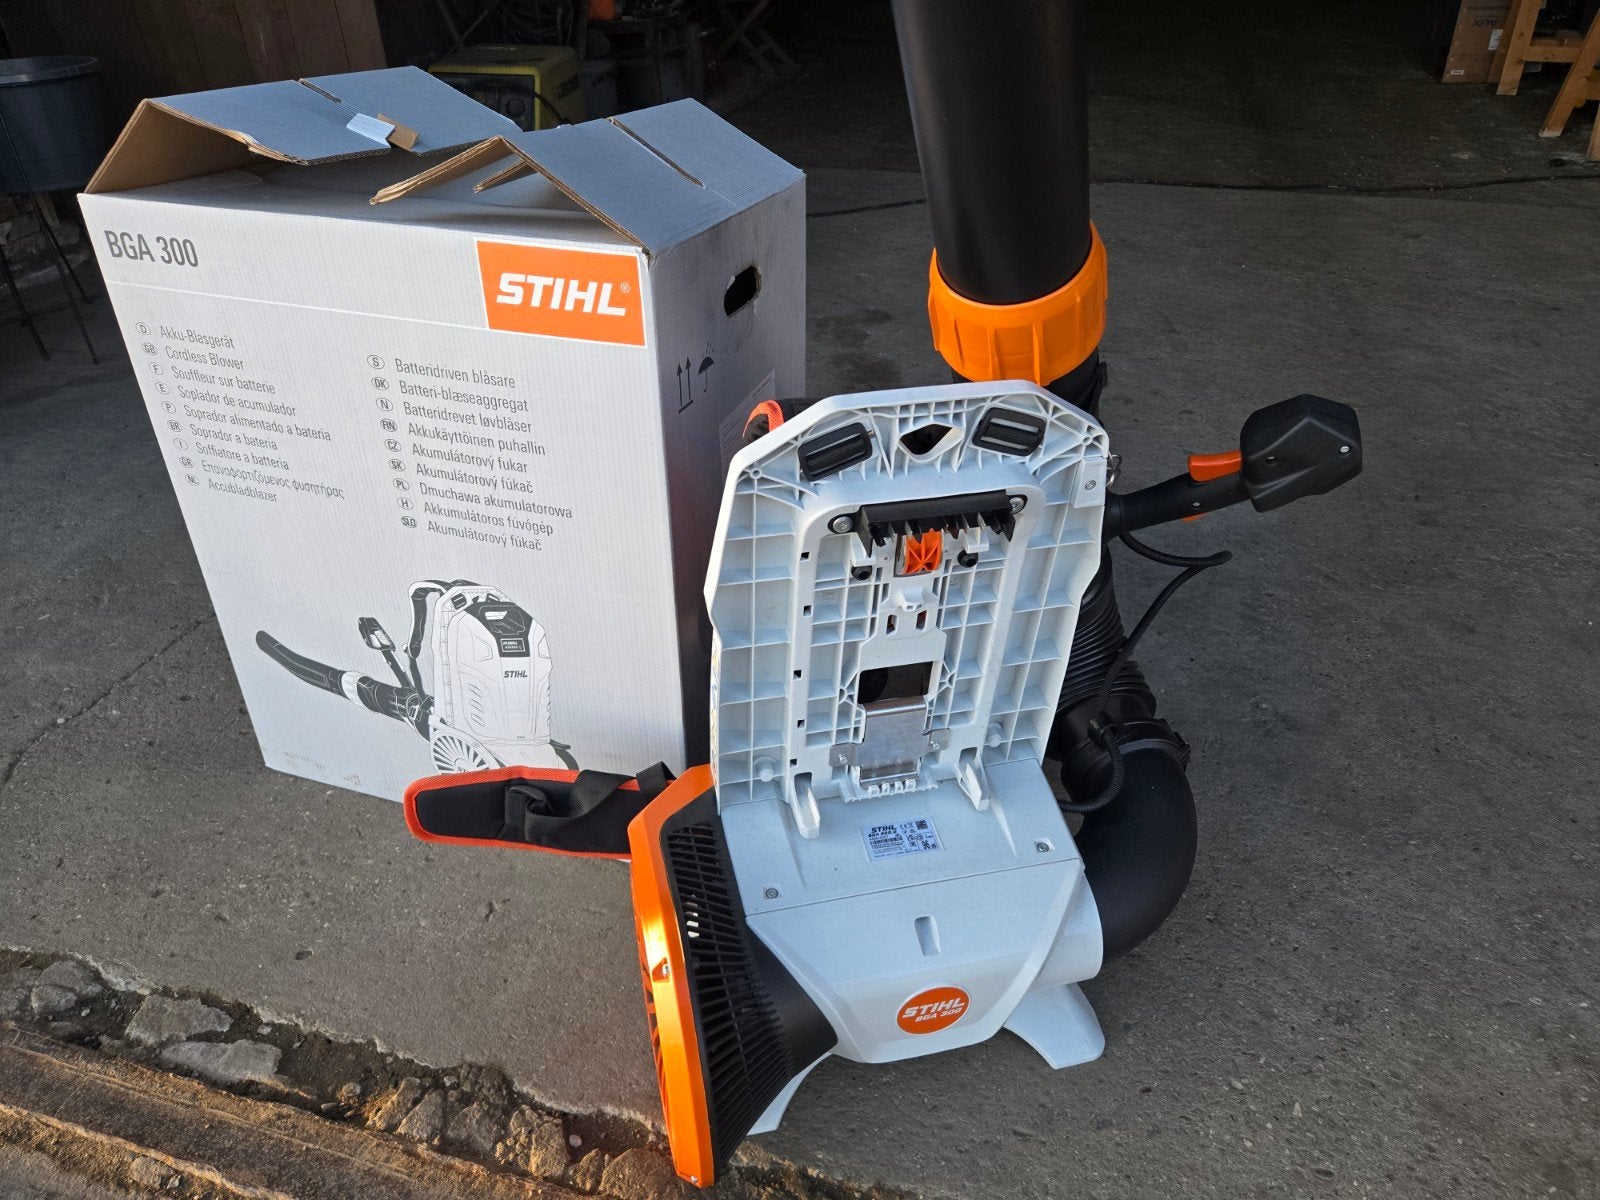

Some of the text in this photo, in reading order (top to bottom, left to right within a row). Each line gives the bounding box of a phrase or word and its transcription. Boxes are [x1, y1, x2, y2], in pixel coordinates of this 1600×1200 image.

[104, 230, 198, 267] BGA 300
[496, 272, 626, 316] STIHL
[160, 326, 235, 349] Akku-Blasgerät
[166, 346, 207, 364] Cordless
[209, 353, 244, 370] Blower
[172, 366, 216, 384] Souffleur
[219, 376, 234, 388] sur
[236, 377, 276, 394] batterie
[395, 358, 469, 382] Batteridriven
[472, 370, 516, 389] blåsare
[178, 386, 220, 403] Soplador
[223, 394, 236, 407] de
[238, 398, 296, 416] acumulador
[403, 401, 477, 426] Batteridrevet
[184, 405, 227, 422] Soprador
[230, 414, 284, 434] alimentado
[295, 424, 331, 441] bateria
[190, 423, 233, 441] Soprador
[243, 433, 278, 451] bateria
[196, 442, 241, 459] Soffiatore
[251, 452, 289, 470] batteria
[412, 443, 495, 471] Akumulátorový
[498, 457, 528, 474] fukar
[498, 439, 546, 456] puhallin
[416, 463, 498, 490] Akumulátorový
[501, 477, 534, 494] fúkač
[419, 482, 480, 504] Dmuchawa
[484, 494, 572, 518] akumulatorowa
[424, 501, 504, 527] Akkumulátoros
[428, 520, 507, 548] Akumulátorový
[503, 670, 528, 678] STIHL
[872, 825, 897, 833] STIHL
[902, 997, 966, 1019] STIHL
[914, 1007, 963, 1023] BGA 300
